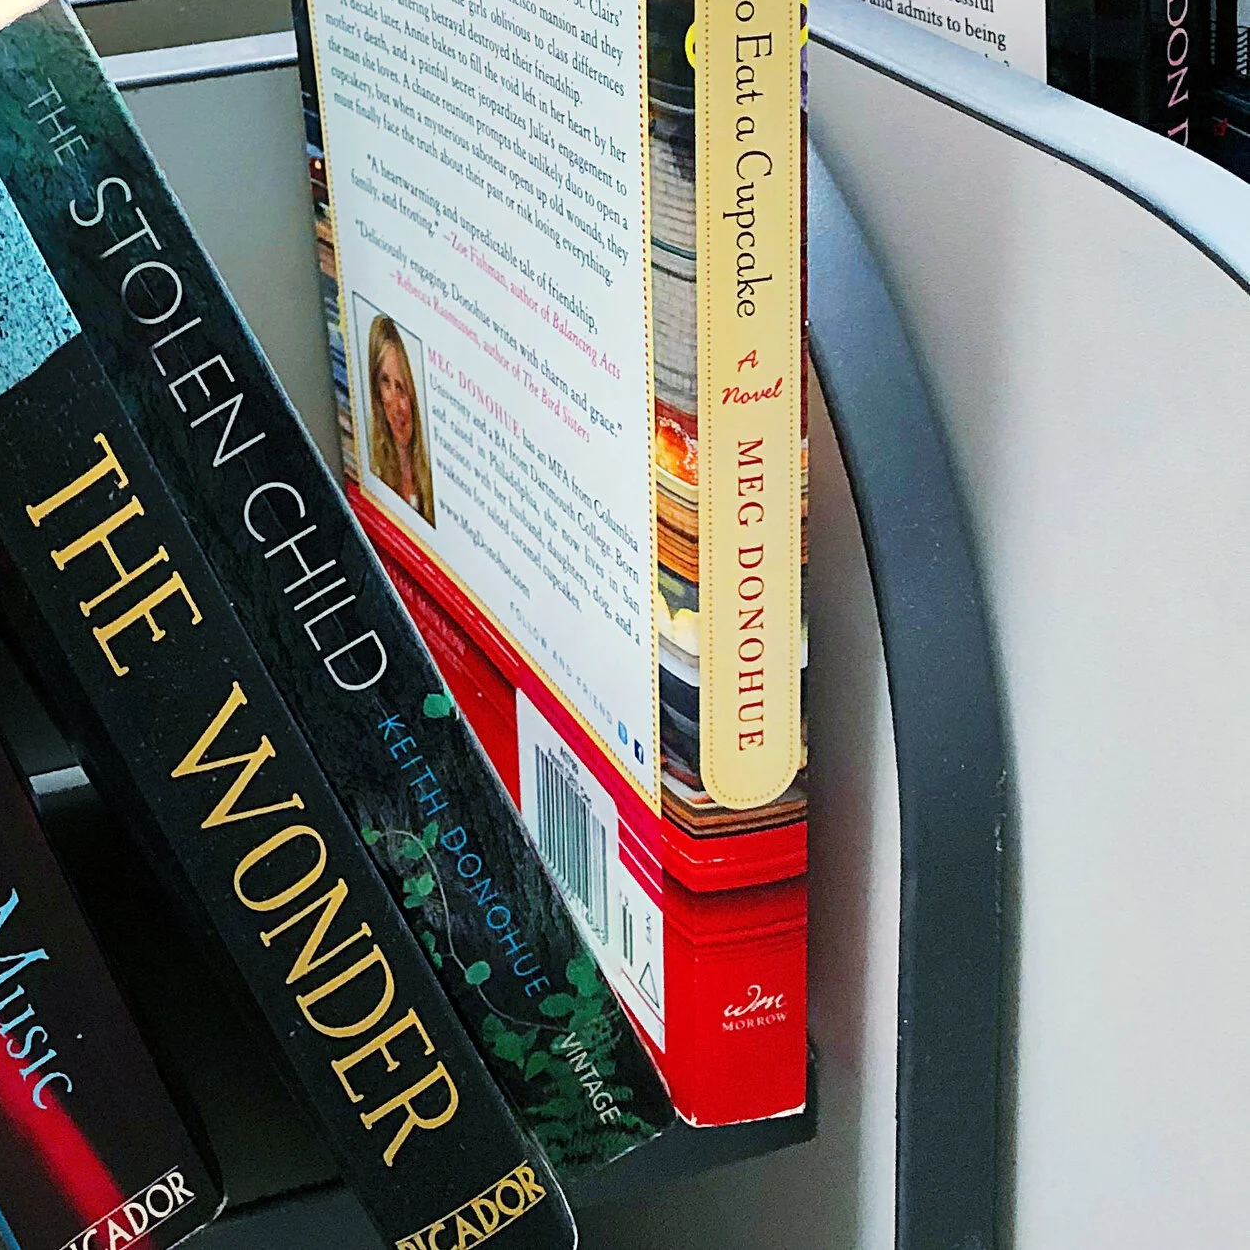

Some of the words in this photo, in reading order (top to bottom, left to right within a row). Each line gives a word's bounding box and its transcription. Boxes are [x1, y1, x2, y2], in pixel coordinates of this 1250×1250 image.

[490, 6, 531, 42] oblivious
[534, 33, 544, 50] to
[547, 37, 568, 64] class
[571, 50, 624, 96] differences
[539, 6, 577, 38] mansion
[580, 29, 597, 49] and
[600, 34, 623, 66] they
[897, 0, 943, 27] admits
[947, 16, 961, 33] to
[965, 17, 1006, 51] being
[467, 22, 510, 61] destroyed
[511, 47, 532, 73] their
[534, 59, 582, 107] friendship.
[735, 32, 773, 106] Eat
[528, 117, 555, 149] Julia's
[558, 142, 612, 187] engagement
[616, 179, 627, 196] to
[736, 117, 758, 141] a
[562, 237, 613, 287] everything.
[722, 149, 774, 318] Cupcake
[548, 277, 597, 334] friendship,
[552, 311, 597, 367] Balancing
[599, 352, 620, 379] Acts
[737, 350, 759, 370] A
[721, 378, 783, 406] Novel
[738, 439, 765, 528] MEG
[27, 79, 90, 166] THE
[70, 175, 265, 468] STOLEN
[242, 481, 389, 690] CHILD
[377, 714, 448, 816] KEITH
[440, 826, 550, 997] DONOHUE
[738, 544, 766, 752] DONOHUE
[26, 433, 203, 677] THE
[170, 681, 459, 1167] WONDER
[722, 1011, 789, 1032] MORROW
[562, 1032, 622, 1125] VINTAGE
